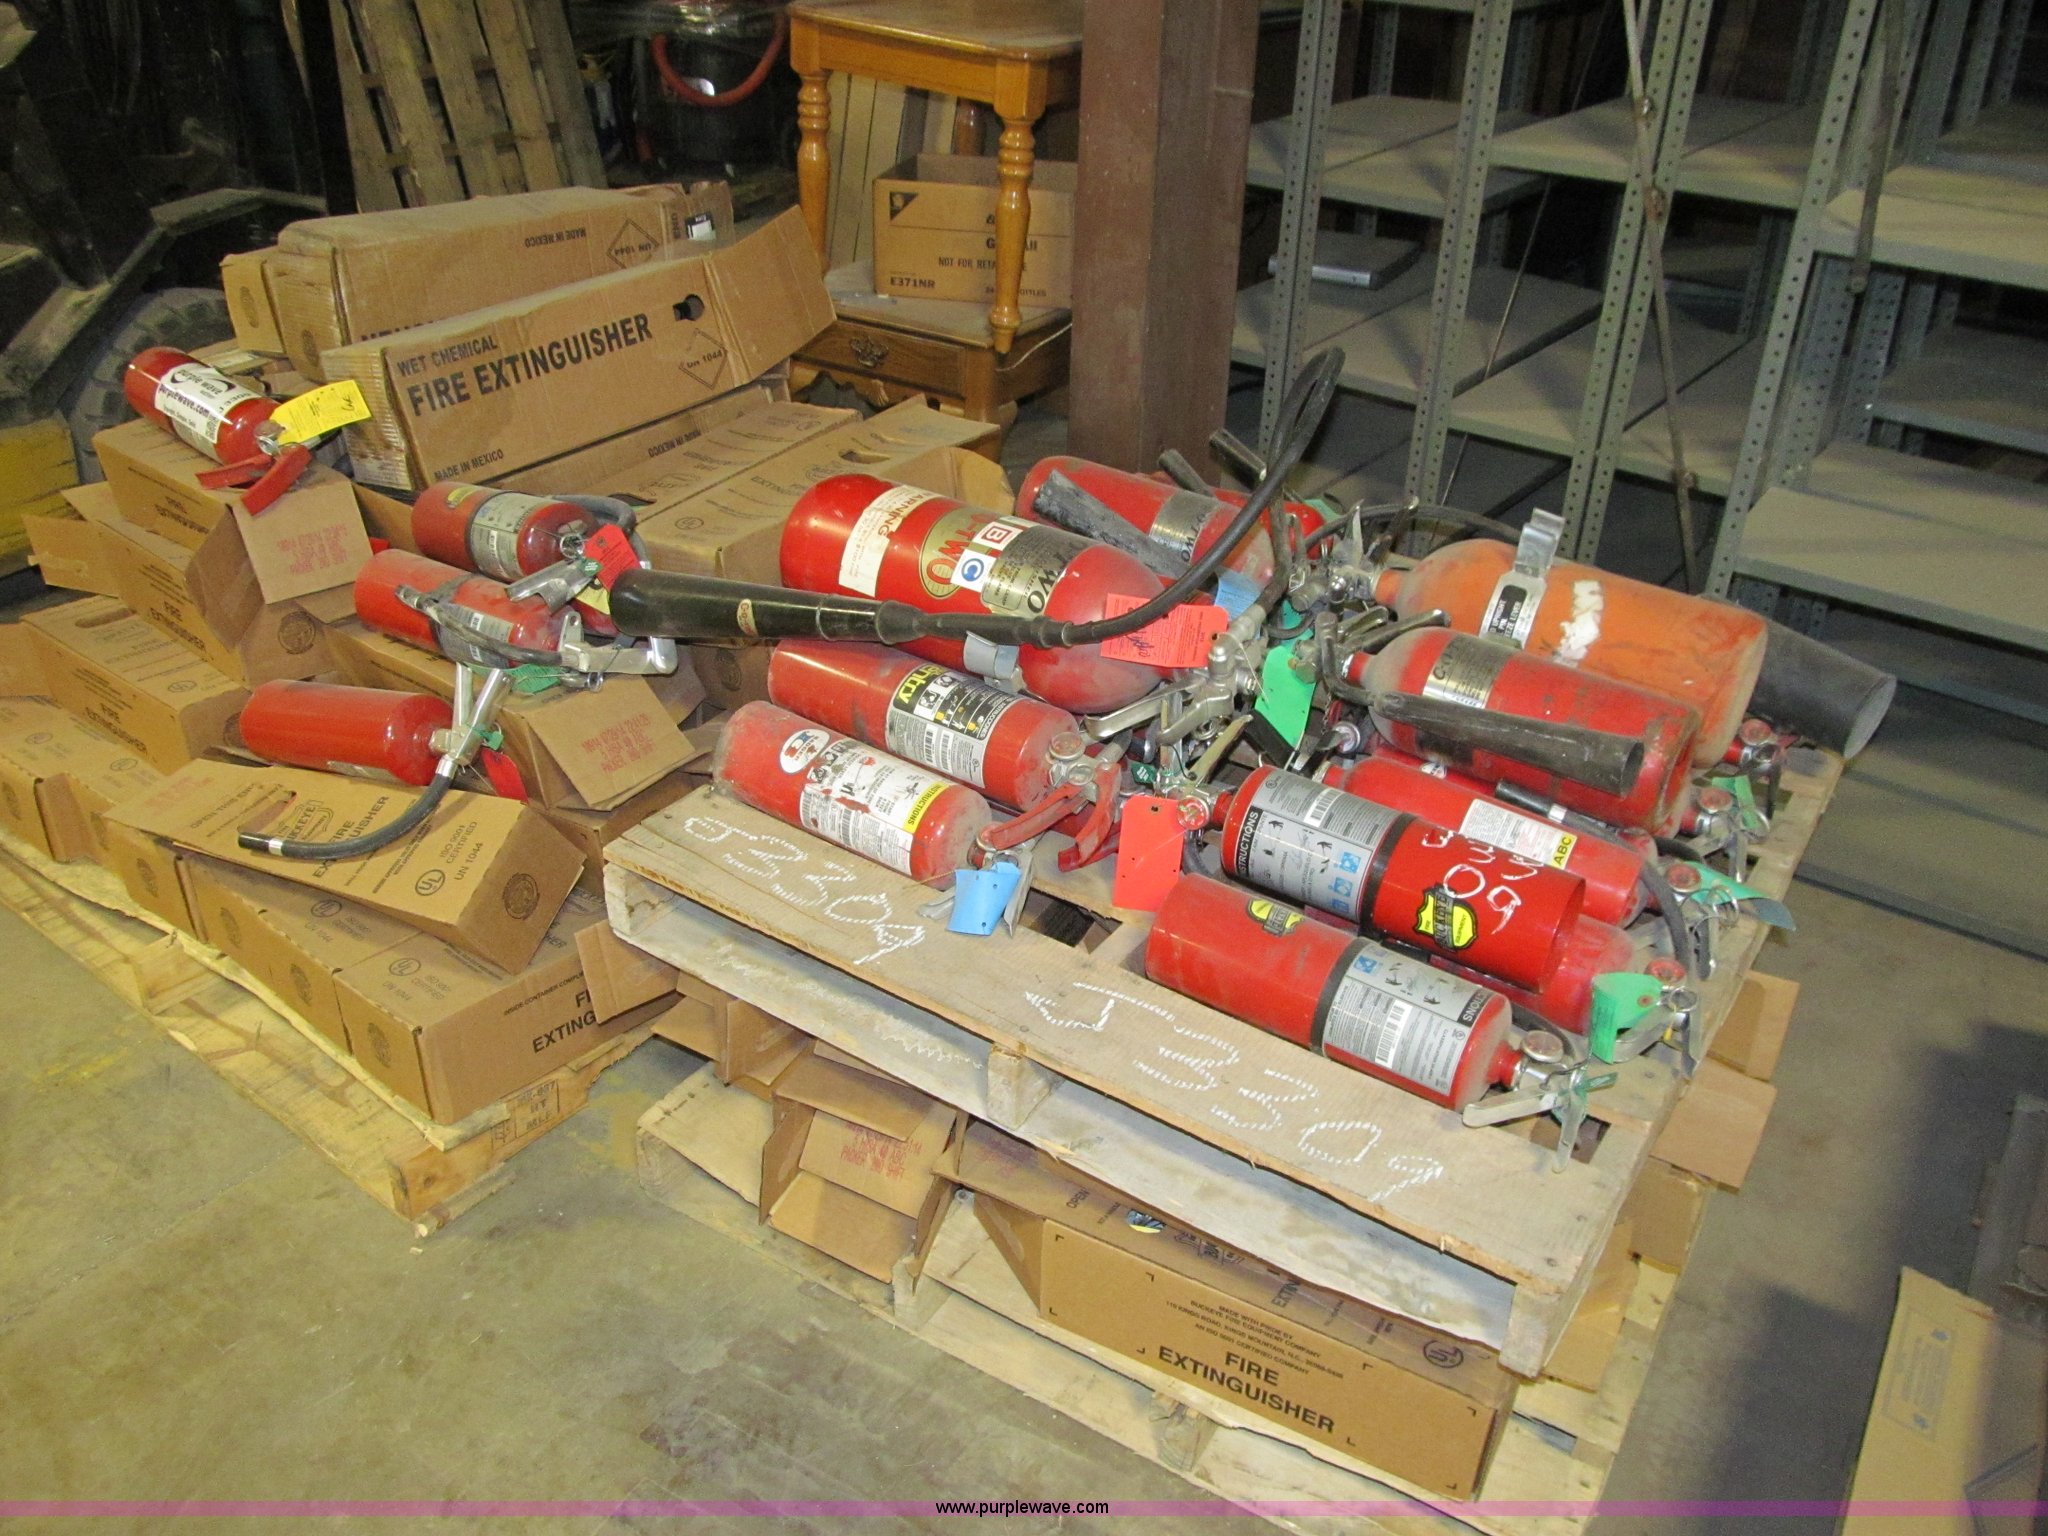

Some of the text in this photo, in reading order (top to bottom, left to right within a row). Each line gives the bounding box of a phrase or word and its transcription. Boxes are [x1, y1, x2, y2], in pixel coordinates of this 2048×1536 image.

[525, 227, 587, 249] MADE IN MEXICO
[938, 256, 953, 267] NOT
[957, 258, 973, 269] FOR
[890, 277, 936, 289] E371NR
[1019, 288, 1047, 297] OTTLES
[398, 335, 498, 378] WET CHEMICAL
[407, 371, 472, 417] FIRE
[473, 313, 653, 396] EXTINGUISHER
[702, 348, 727, 364] 1044
[201, 380, 224, 395] wave
[434, 448, 504, 480] MADE IN MEXICO
[648, 439, 676, 458] MEXICO
[877, 491, 928, 537] ARNING
[1510, 601, 1522, 621] LEVER
[898, 664, 946, 704] entry
[85, 706, 148, 753] EXTINGUISHER
[907, 783, 946, 826] INSTRUCTIONS
[287, 806, 317, 840] UCKEYE
[446, 821, 477, 864] CERTIFIED
[1239, 811, 1260, 872] STRUCTIONS
[1553, 836, 1573, 866] ABC
[453, 842, 484, 881] UN 1044
[419, 873, 442, 893] UL
[503, 970, 585, 1016] INSIDE CONTAINER COMPLI
[575, 989, 592, 1008] FI
[532, 1010, 598, 1054] EXTING
[1066, 1186, 1091, 1209] OPEN
[1178, 1306, 1201, 1319] KINGS
[1223, 1323, 1247, 1339] KINGS
[1190, 1300, 1322, 1359] BUCKEYE FIRE EQUIPMENT COMPANY
[1218, 1305, 1294, 1341] MADE WITH PRIDE BY
[1194, 1322, 1206, 1333] AN
[1205, 1327, 1219, 1338] ISO
[1236, 1339, 1274, 1361] CERTIFIED
[1273, 1355, 1310, 1376] COMPANY
[1224, 1350, 1281, 1388] FIRE
[1158, 1344, 1336, 1434] EXTINGUISHER
